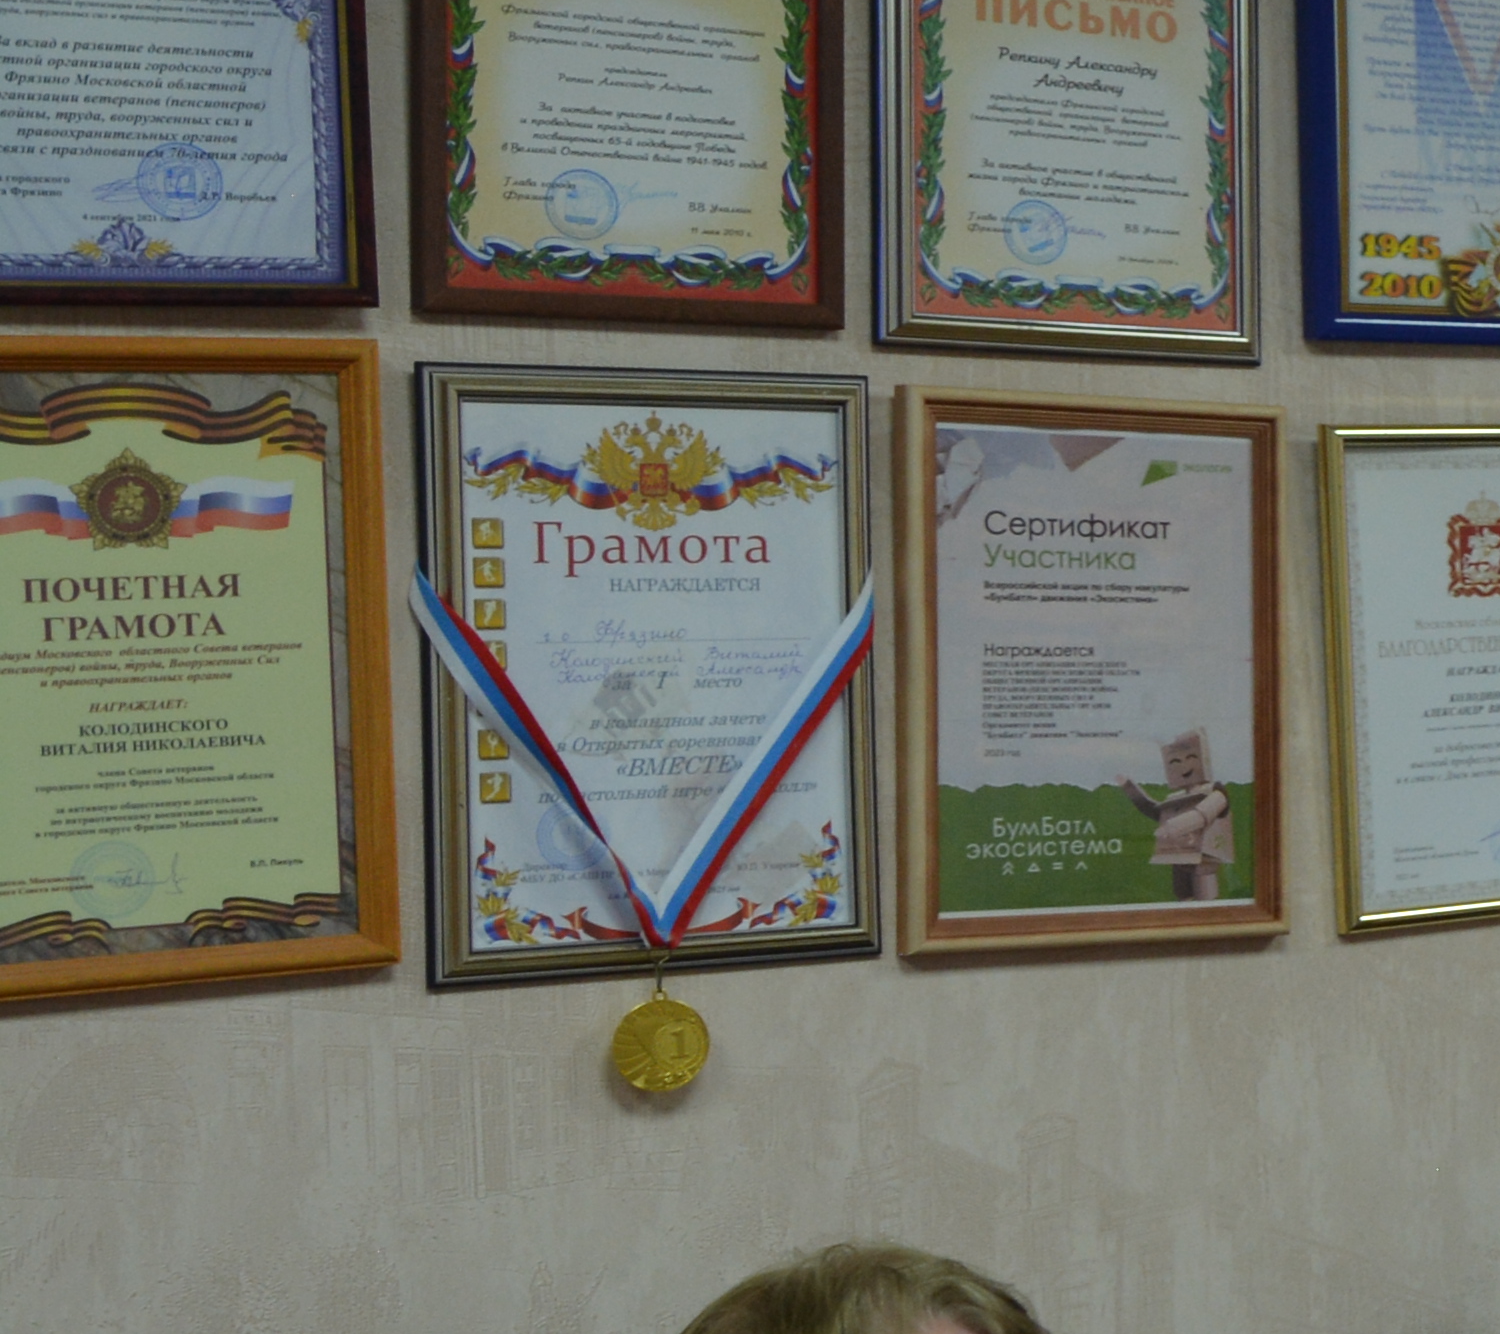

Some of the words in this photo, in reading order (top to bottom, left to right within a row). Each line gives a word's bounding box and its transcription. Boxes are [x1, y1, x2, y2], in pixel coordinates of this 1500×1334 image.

[15, 37, 57, 49] вклад
[73, 41, 143, 53] развитие
[148, 44, 254, 59] деятельности
[48, 58, 141, 72] организации
[145, 62, 222, 75] городского
[227, 66, 272, 78] округа
[998, 46, 1060, 69] Репкину
[1065, 56, 1157, 79] Александру
[5, 71, 70, 85] Фрязино
[74, 74, 163, 89] Московской
[168, 80, 247, 92] областной
[1033, 74, 1124, 97] Андреевичу
[84, 95, 161, 107] ветеранов
[166, 97, 266, 112] (пенсионеров)
[110, 112, 210, 126] вооруженных
[215, 116, 240, 127] сил
[17, 127, 177, 142] правоохранительных
[182, 132, 238, 144] органов
[241, 152, 288, 163] города
[1360, 232, 1441, 262] 1945
[1360, 271, 1443, 300] 2010
[984, 510, 1171, 543] Сертификат
[532, 521, 770, 577] Грамота
[984, 543, 1137, 570] Участника
[23, 572, 241, 606] ПОЧЕТНАЯ
[609, 577, 760, 593] НАГРАЖДАЕТСЯ
[43, 611, 226, 644] ГРАМОТА
[984, 644, 1094, 658] Награждается
[694, 675, 742, 690] место
[79, 718, 229, 737] КОЛОДИНСКОГО
[604, 715, 704, 731] командном
[709, 713, 766, 727] зачете
[40, 740, 128, 757] ВИТАЛИЯ
[132, 735, 266, 753] НИКОЛАЕВИЧА
[571, 735, 662, 754] Открытых
[616, 755, 743, 777] «ВМЕСТЕ»
[992, 816, 1096, 841] БумБатл
[966, 838, 1122, 859] экосистема
